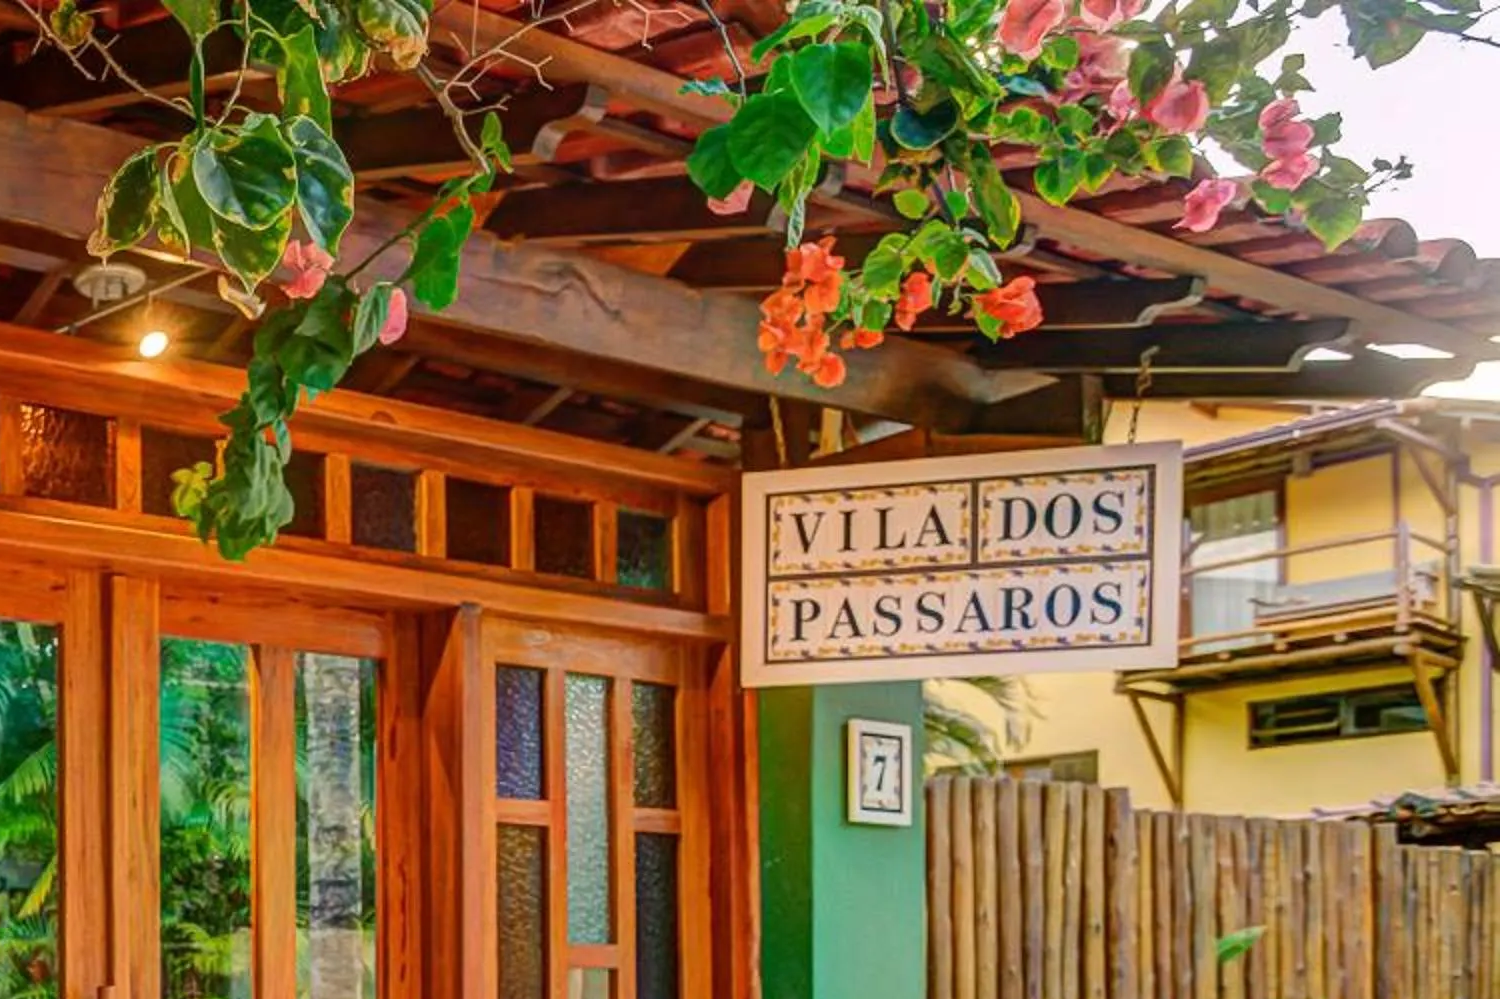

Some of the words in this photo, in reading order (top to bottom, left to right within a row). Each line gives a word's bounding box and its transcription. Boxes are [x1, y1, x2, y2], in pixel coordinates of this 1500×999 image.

[790, 503, 953, 555] VILA
[999, 490, 1126, 543] DOS
[789, 581, 1124, 643] PASSAROS
[871, 755, 888, 792] 7
